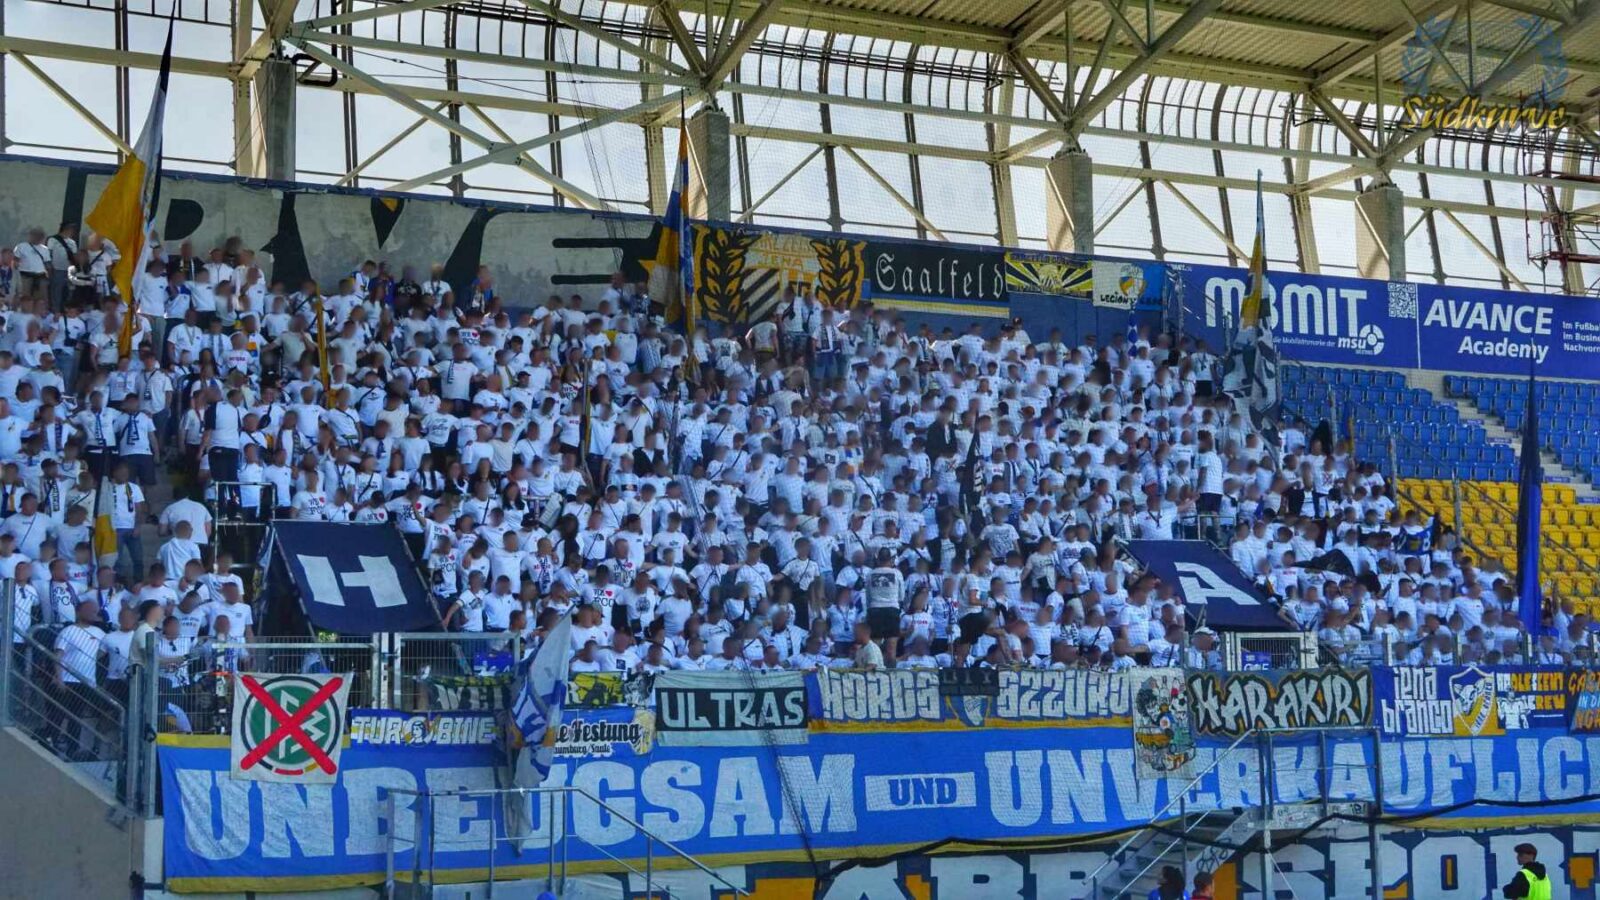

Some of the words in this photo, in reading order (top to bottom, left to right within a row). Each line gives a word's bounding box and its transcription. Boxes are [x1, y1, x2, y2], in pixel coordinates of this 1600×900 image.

[875, 252, 1004, 299] Saalfeld
[1423, 298, 1554, 335] AVANCE
[1337, 336, 1367, 350] msu
[1457, 335, 1550, 364] Academy
[296, 553, 408, 608] H
[1174, 561, 1261, 605] A
[660, 690, 804, 728] ULTRAS
[1188, 673, 1371, 734] HARAKIRI
[571, 719, 641, 745] Festung
[176, 752, 857, 860] UNBEUGSAM
[888, 777, 957, 806] UND
